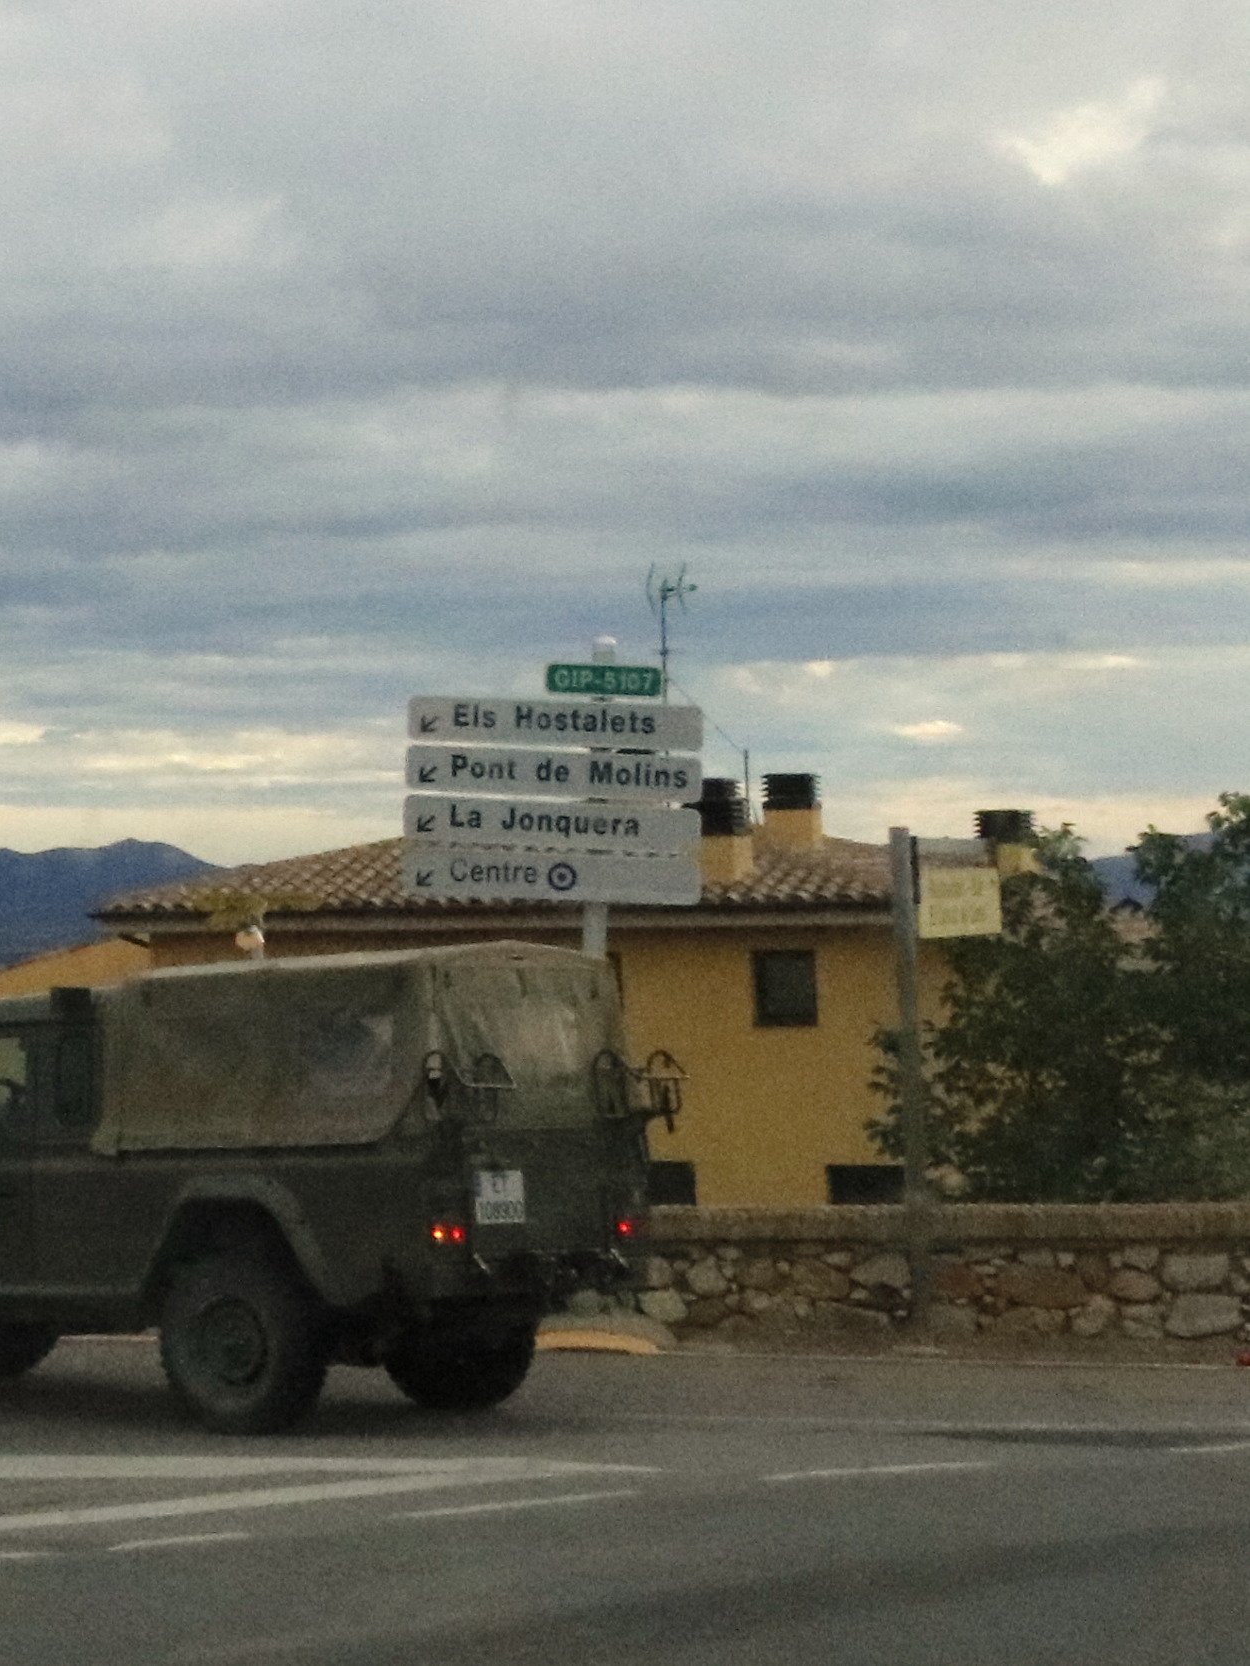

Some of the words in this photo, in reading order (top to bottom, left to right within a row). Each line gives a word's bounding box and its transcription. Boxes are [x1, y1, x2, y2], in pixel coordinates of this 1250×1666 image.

[453, 703, 496, 728] Els
[515, 705, 656, 734] Hostalets
[451, 754, 516, 780] Pont
[535, 758, 570, 783] de
[589, 760, 688, 789] Molins
[449, 804, 482, 829] La
[501, 807, 641, 838] Jonquera
[449, 858, 538, 884] Centre
